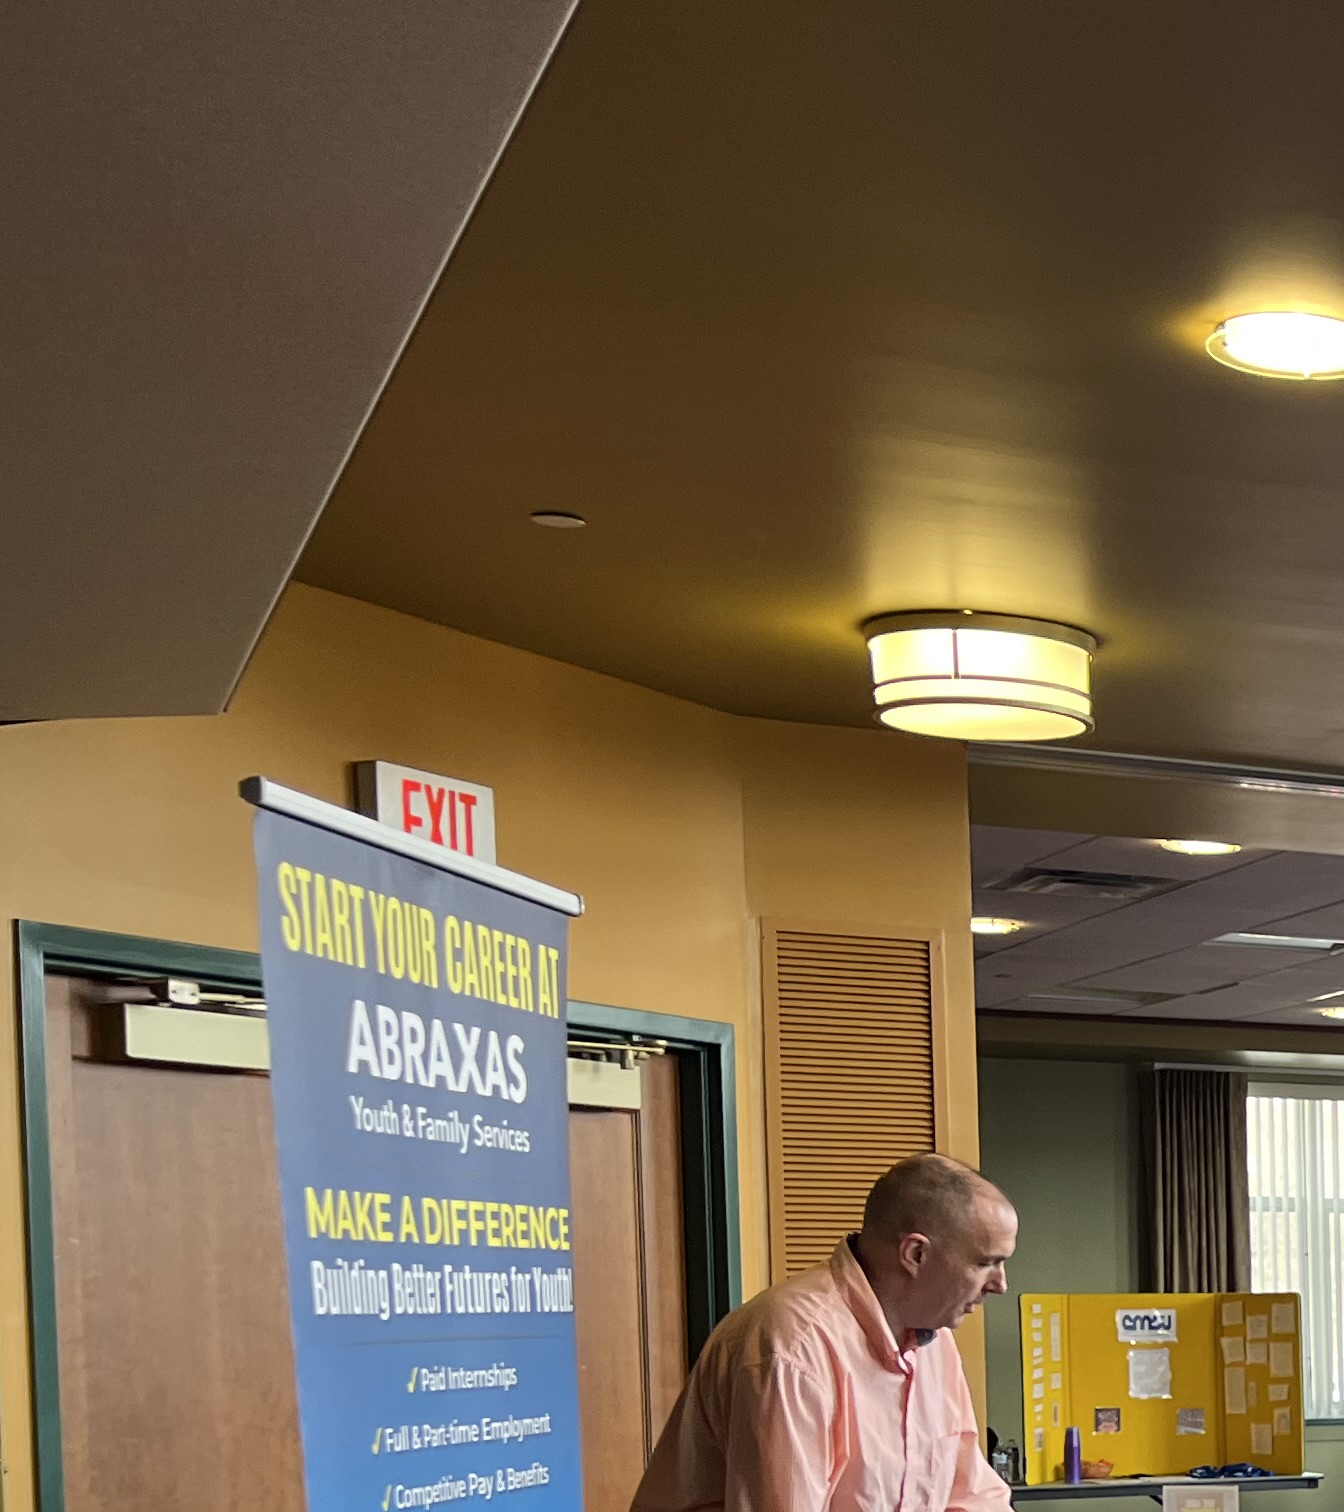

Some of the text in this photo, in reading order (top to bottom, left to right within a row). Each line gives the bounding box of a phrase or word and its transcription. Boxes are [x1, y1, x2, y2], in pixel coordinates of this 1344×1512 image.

[402, 779, 477, 857] EXIT
[277, 861, 559, 1020] START YOUR CAREER AT
[347, 1000, 527, 1104] ABRAXAS
[350, 1096, 530, 1154] Youth & Family Services
[305, 1187, 570, 1250] MAKE A DIFFERENCE
[310, 1258, 390, 1320] Building
[391, 1263, 441, 1314] Better
[443, 1264, 508, 1313] Futures
[510, 1266, 530, 1313] for
[421, 1362, 517, 1391] Paid Internships
[385, 1413, 551, 1452] Full & Part-time Employment
[395, 1462, 549, 1510] Competitive Pay & Benefits
